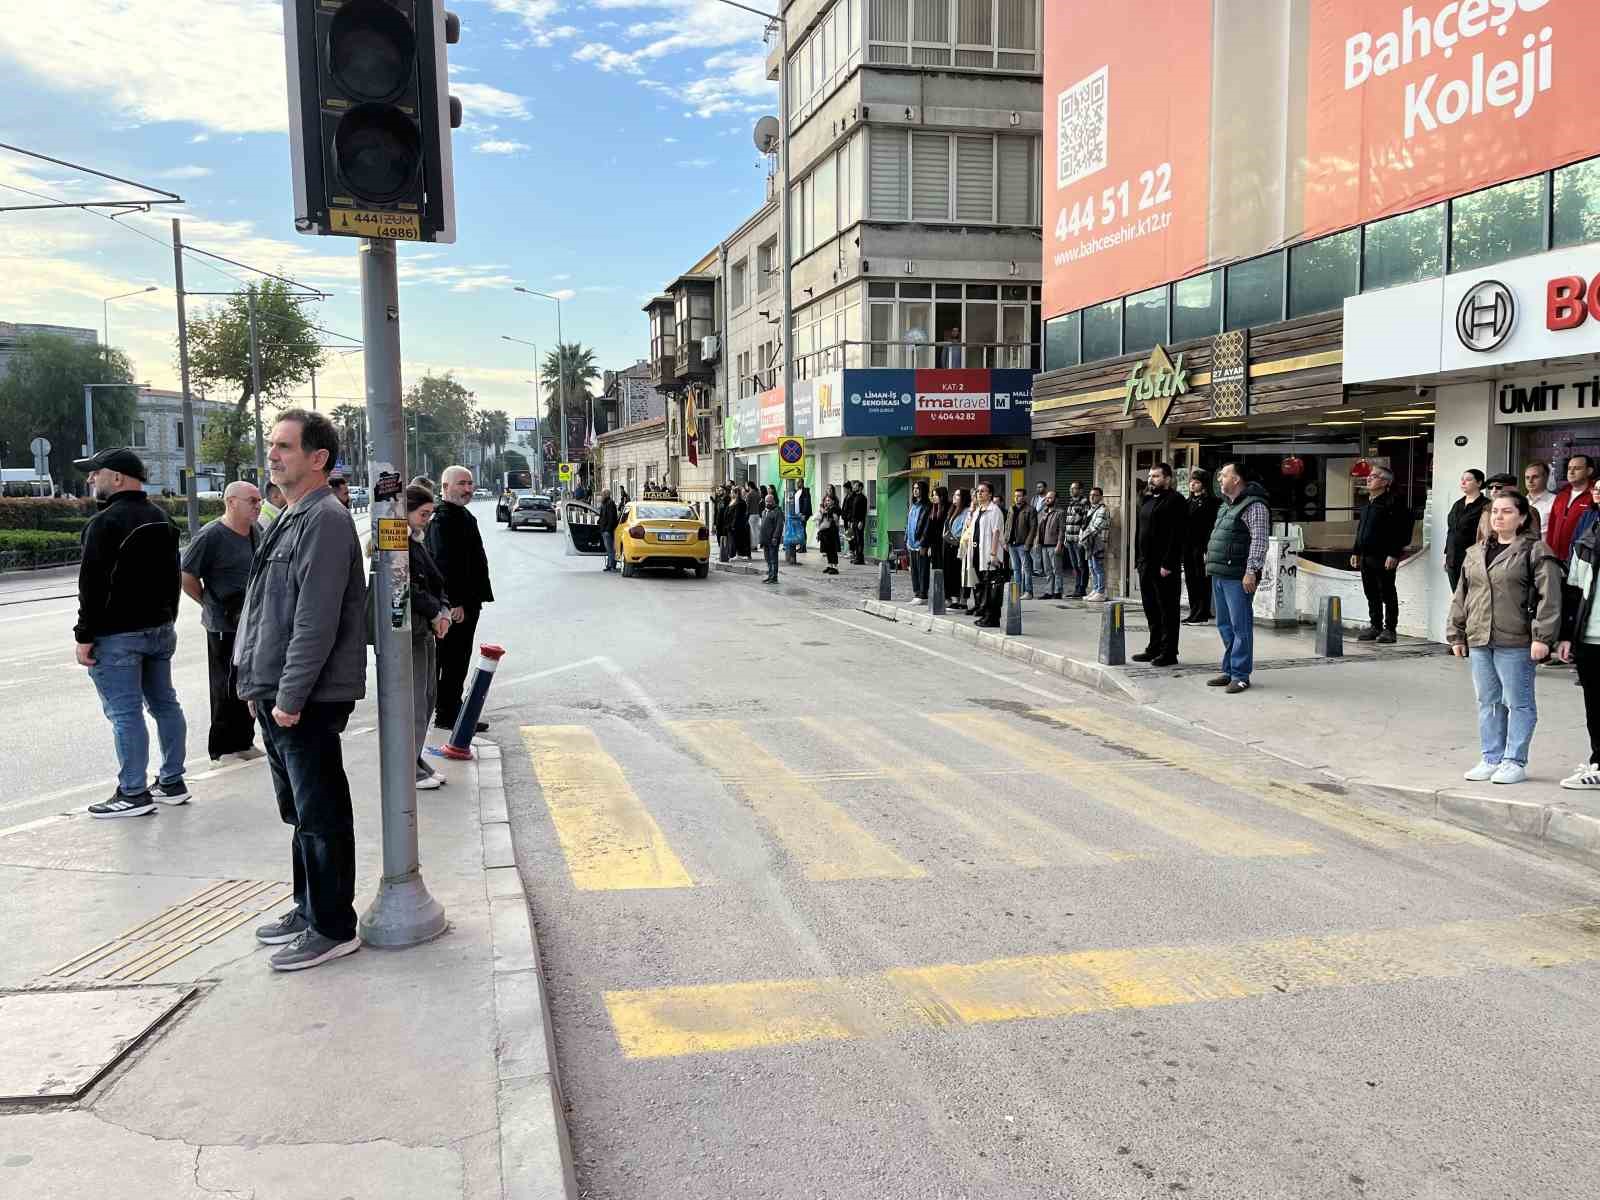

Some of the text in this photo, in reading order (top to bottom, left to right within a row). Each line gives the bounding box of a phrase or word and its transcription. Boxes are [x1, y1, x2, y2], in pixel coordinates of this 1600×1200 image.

[1404, 26, 1553, 139] Koleji
[1055, 161, 1173, 242] 444 51 22
[376, 225, 418, 239] (4986)
[1054, 211, 1173, 267] www.bahcesehir.k12.tr
[1223, 367, 1244, 376] AYAR
[1499, 381, 1564, 414] ÜMİT
